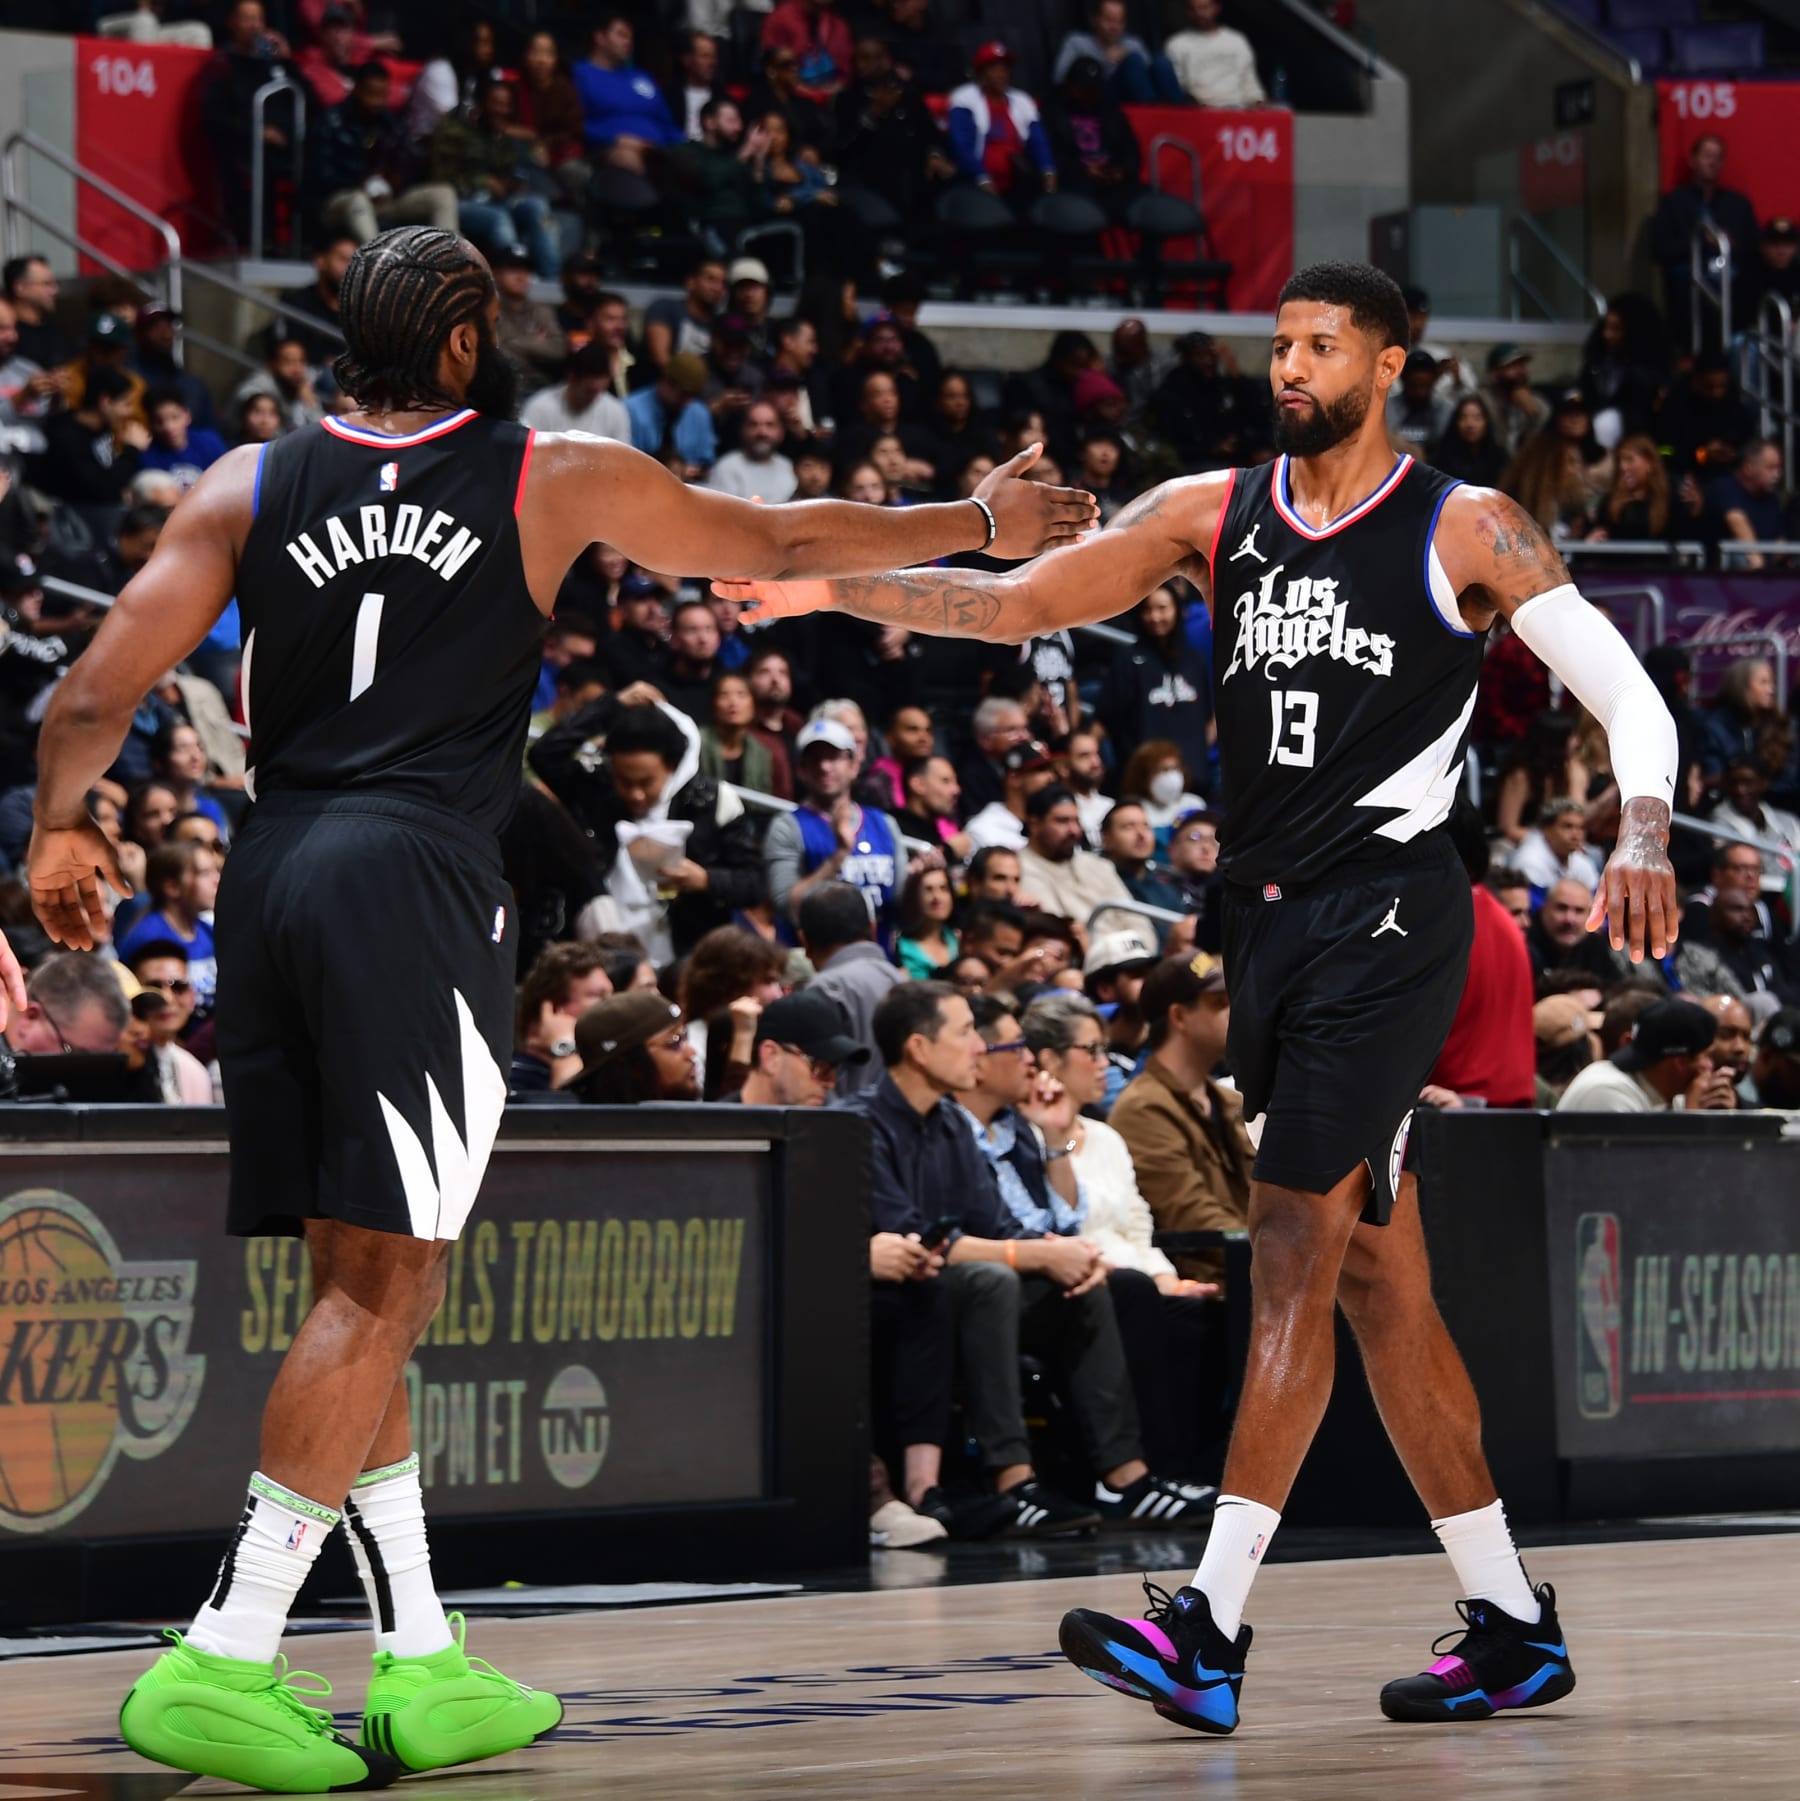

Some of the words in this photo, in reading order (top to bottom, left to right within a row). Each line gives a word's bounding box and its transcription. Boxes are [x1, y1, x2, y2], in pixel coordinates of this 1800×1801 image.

[89, 54, 158, 98] 104
[1671, 84, 1737, 119] 105
[1216, 125, 1279, 163] 104
[286, 503, 482, 588] HARDEN
[1252, 564, 1339, 618] Los
[350, 592, 385, 702] 1
[1222, 591, 1396, 686] Angeles
[1267, 690, 1320, 768] 13
[0, 1278, 49, 1306] LOS
[52, 1275, 184, 1304] ANGELES
[510, 1217, 745, 1343] TOMORROW
[486, 1380, 527, 1484] ET
